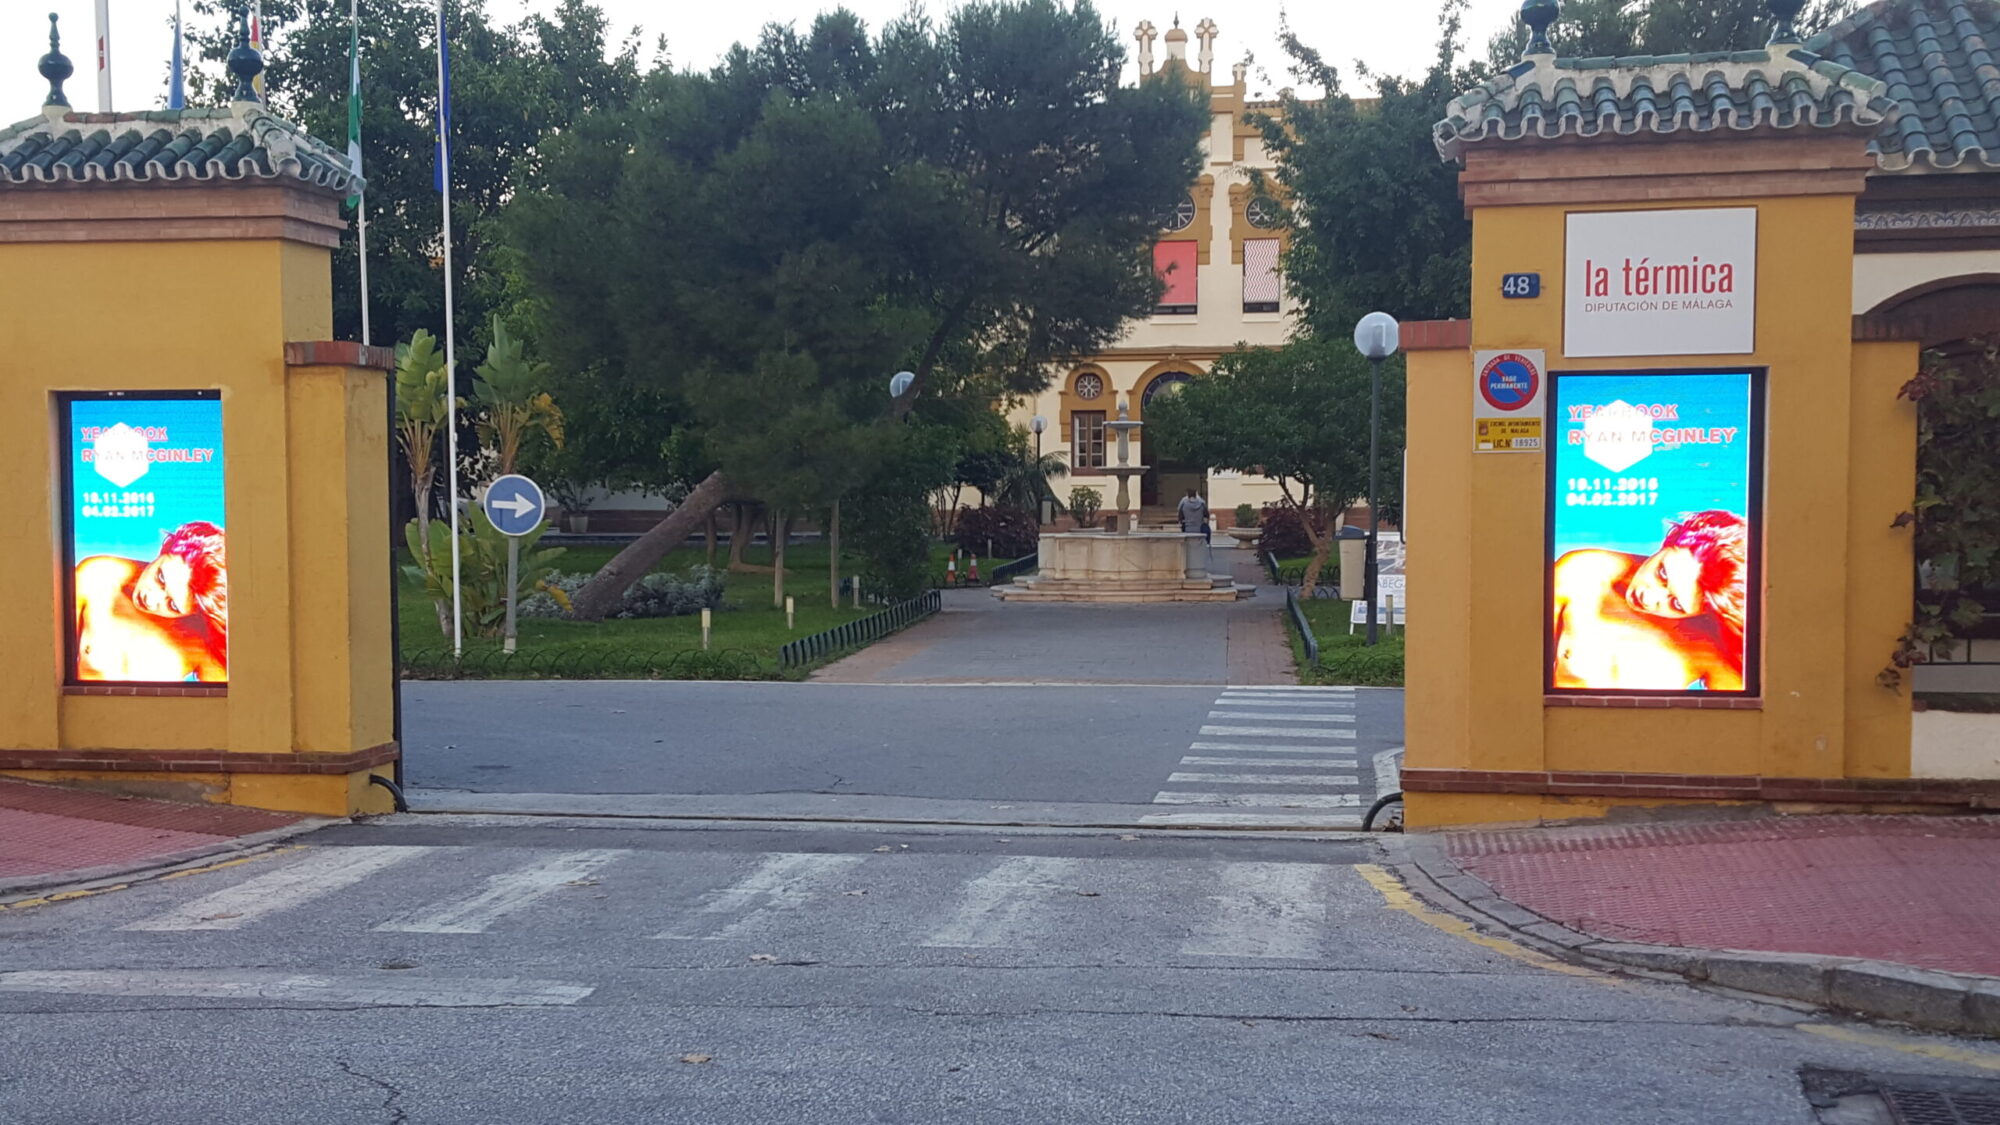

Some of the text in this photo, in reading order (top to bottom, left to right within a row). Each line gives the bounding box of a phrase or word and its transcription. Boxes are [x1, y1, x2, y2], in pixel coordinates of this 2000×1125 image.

[1585, 256, 1733, 297] la térmica
[1503, 276, 1530, 295] 48
[1585, 298, 1733, 313] DIPUTACIÓN DE MÁLAGA
[1568, 404, 1679, 421] YEAOOK
[81, 426, 168, 442] YEOOK
[81, 449, 125, 462] RY
